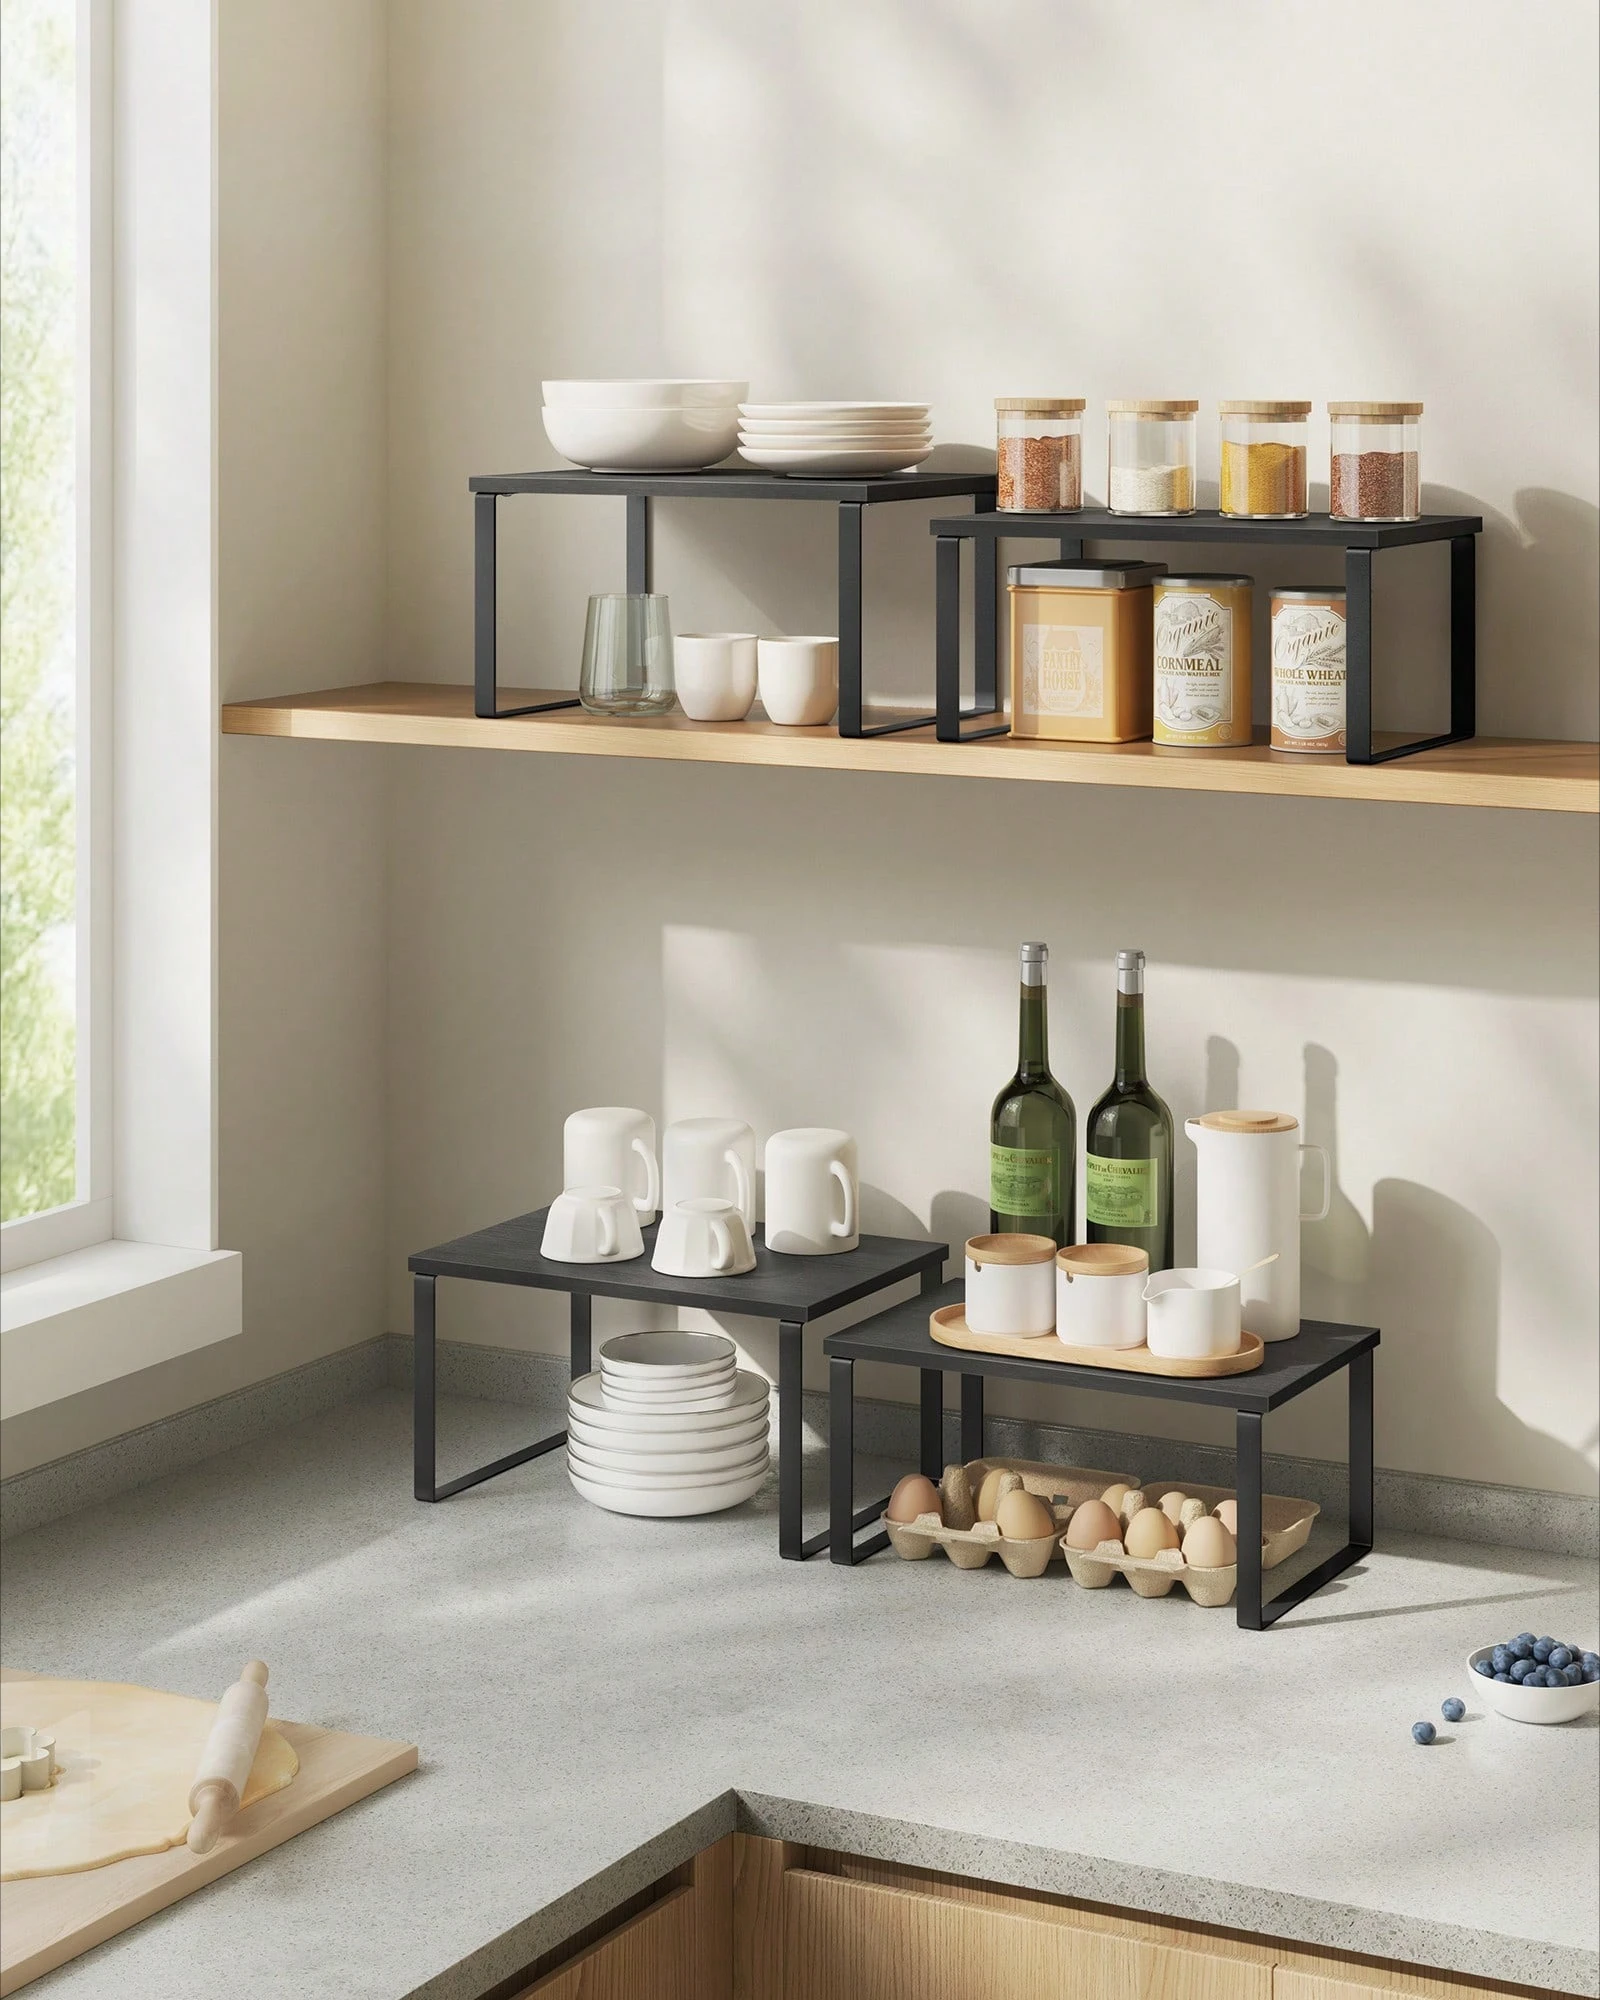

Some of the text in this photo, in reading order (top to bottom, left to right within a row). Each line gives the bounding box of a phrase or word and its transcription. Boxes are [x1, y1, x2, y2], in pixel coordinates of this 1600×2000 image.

[1156, 609, 1218, 654] Organic
[1274, 621, 1338, 661] Organic
[1043, 651, 1082, 670] PANTRY
[1157, 656, 1223, 671] CORNMEAL
[1043, 670, 1081, 690] HOUSE
[1274, 667, 1347, 680] WHOLE WHEAT
